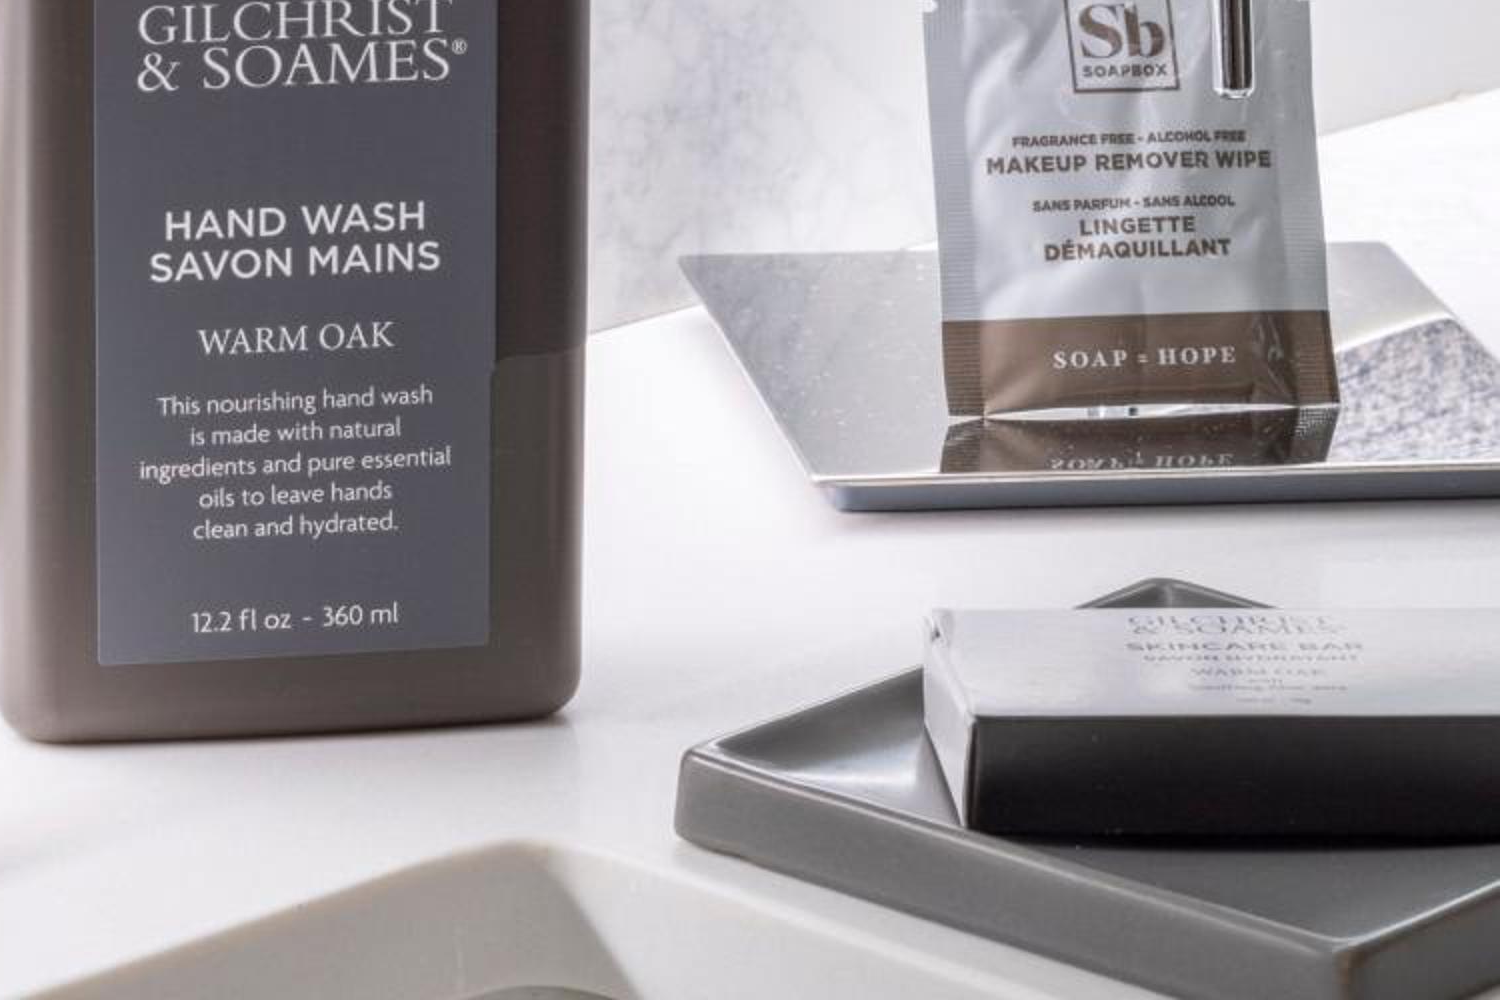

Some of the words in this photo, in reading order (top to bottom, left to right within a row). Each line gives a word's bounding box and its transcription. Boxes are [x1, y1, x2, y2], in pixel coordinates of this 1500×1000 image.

[1078, 2, 1166, 59] Sb
[136, 52, 180, 92] &
[1082, 63, 1168, 78] SOAPBOX
[1012, 134, 1098, 147] FRAGRANCE
[1101, 133, 1136, 145] FREE
[1147, 131, 1211, 144] ALCOHOL
[1214, 130, 1246, 142] FREE
[986, 154, 1086, 175] MAKEUP
[1095, 151, 1209, 171] REMOVER
[1215, 150, 1272, 168] WIPE
[1033, 200, 1070, 212] SANS
[1073, 198, 1130, 211] PARFUM
[1143, 196, 1180, 208] SANS
[1183, 195, 1235, 207] ALCOOL
[165, 207, 286, 241] HAND
[301, 201, 425, 234] WASH
[1079, 215, 1195, 236] LINGETTE
[149, 247, 292, 283] SAVON
[309, 241, 440, 276] MAINS
[1044, 238, 1231, 261] DÉMAQUILLANT
[198, 325, 308, 355] WARM
[319, 322, 395, 349] OAK
[1053, 349, 1128, 369] SOAP
[1158, 346, 1236, 366] HOPE
[157, 397, 200, 416] This
[207, 390, 317, 415] nourishing
[323, 387, 375, 409] hand
[381, 384, 433, 404] wash
[190, 428, 205, 446] is
[211, 423, 270, 445] made
[277, 421, 323, 441] with
[329, 416, 401, 439] natural
[140, 456, 256, 485] ingredients
[262, 453, 301, 474] and
[308, 452, 355, 478] pure
[362, 446, 452, 469] essential
[199, 489, 235, 509] oils
[242, 488, 265, 506] to
[271, 484, 325, 505] leave
[331, 480, 392, 501] hands
[193, 520, 248, 540] clean
[255, 516, 292, 537] and
[300, 509, 399, 539] hydrated.
[192, 611, 231, 633] 12.2
[239, 608, 257, 630] fl
[264, 612, 291, 630] oz
[323, 606, 363, 627] 360
[371, 601, 400, 624] ml
[1299, 643, 1363, 651] BAR
